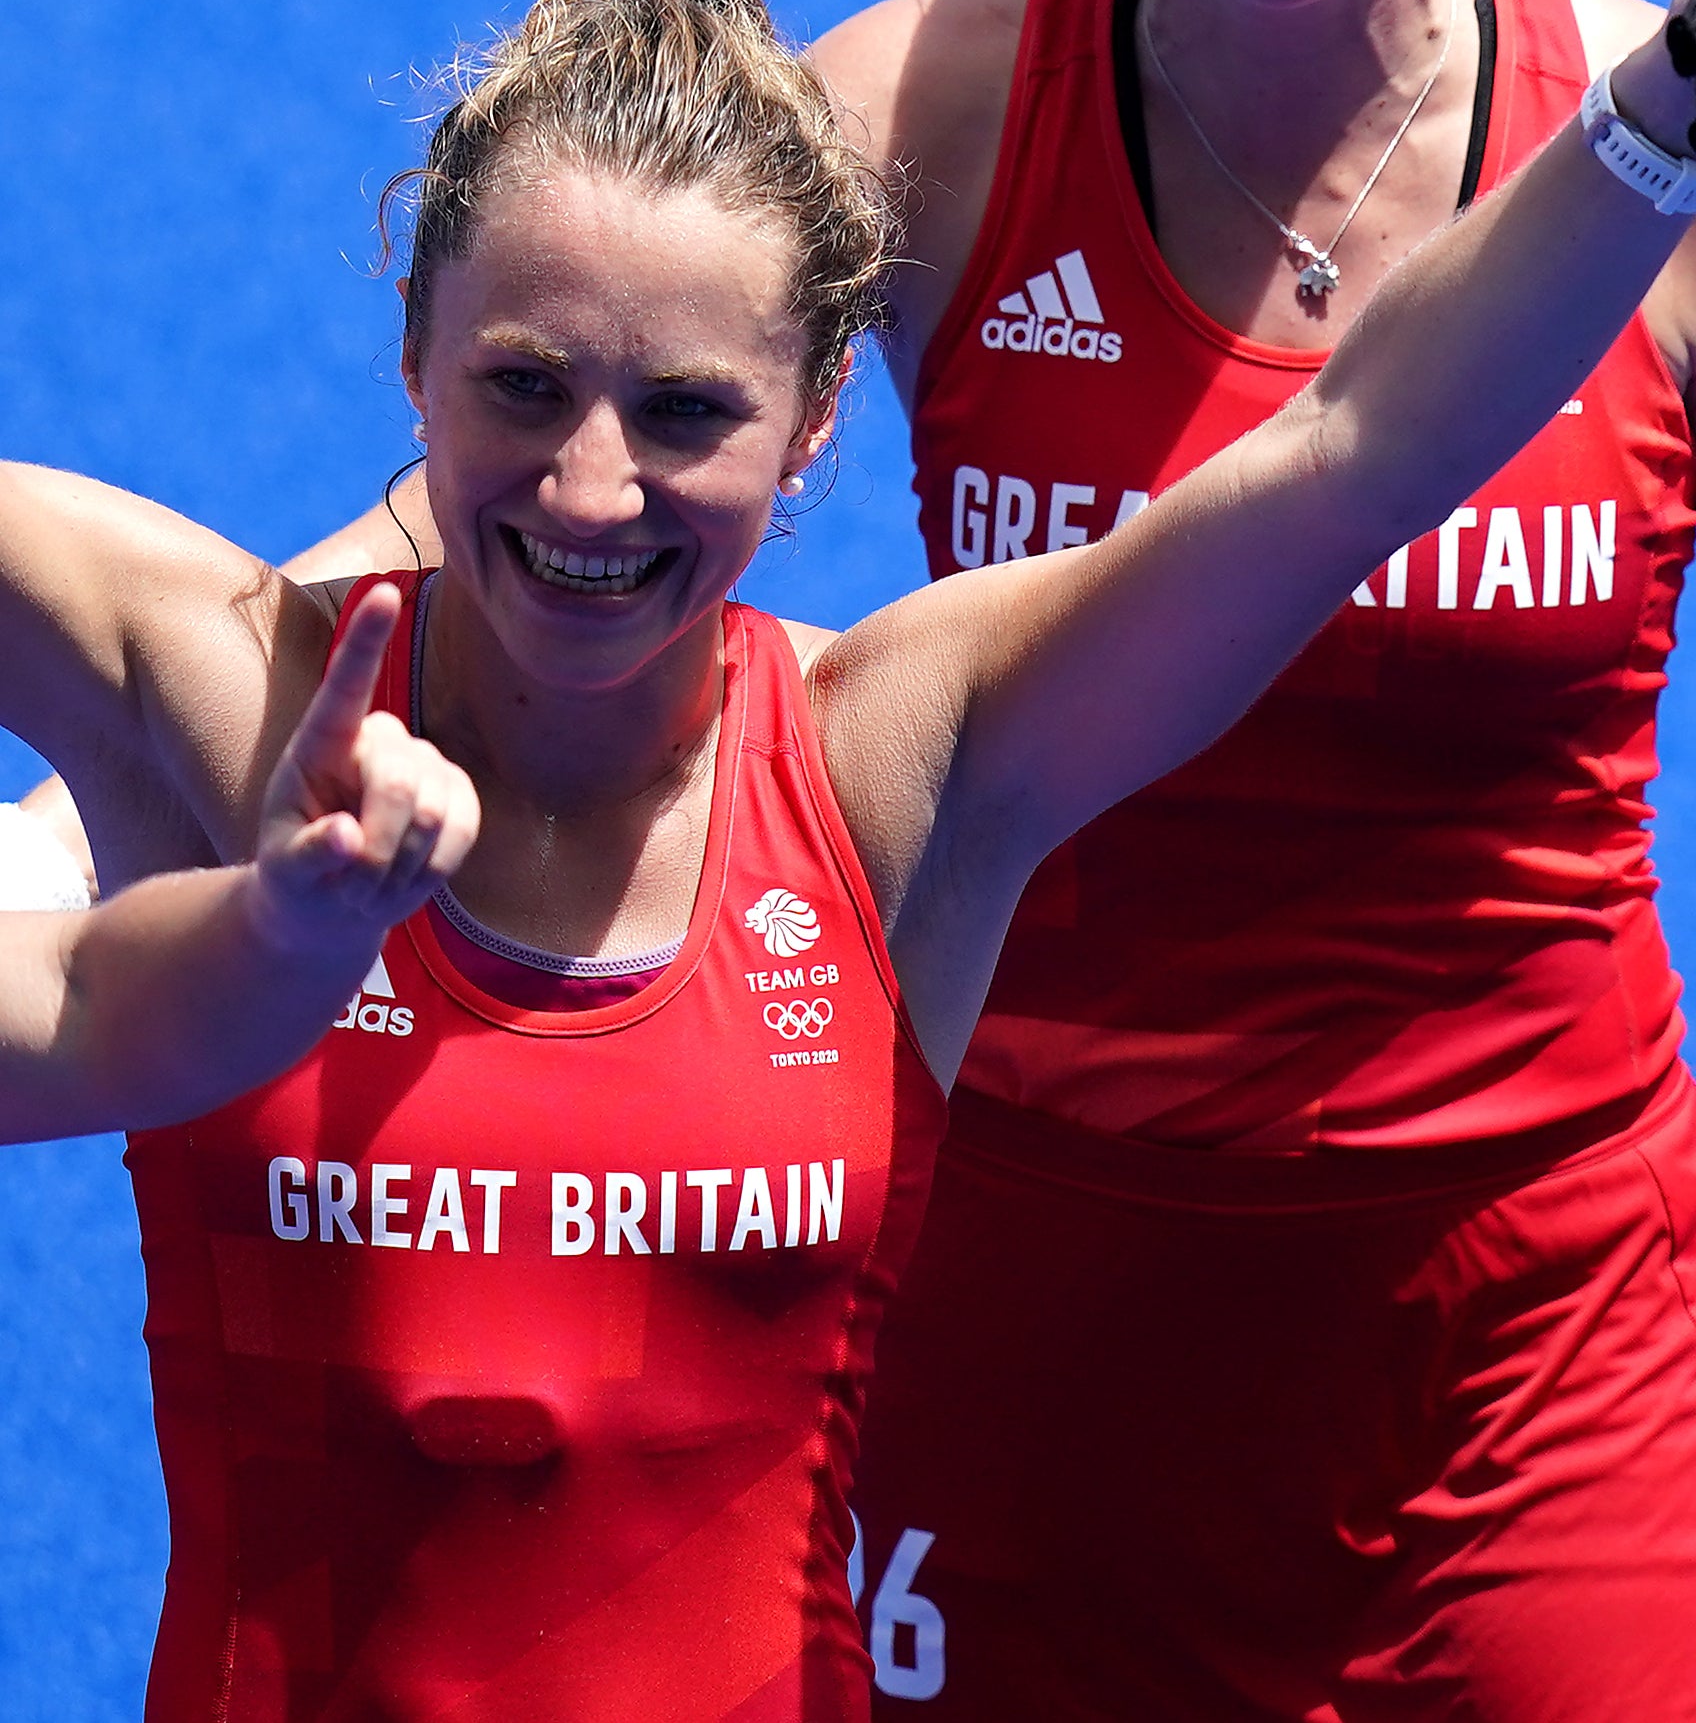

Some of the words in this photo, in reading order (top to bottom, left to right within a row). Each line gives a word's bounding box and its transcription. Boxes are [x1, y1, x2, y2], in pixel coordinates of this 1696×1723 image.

[981, 314, 1122, 363] adidas
[952, 464, 1150, 569] GRE
[744, 967, 805, 993] TEAM
[809, 963, 840, 986] GB
[331, 992, 415, 1036] das
[769, 1051, 811, 1068] TOKYO
[811, 1049, 839, 1065] 2020
[267, 1155, 516, 1255] GREAT
[550, 1157, 846, 1256] BRITAIN
